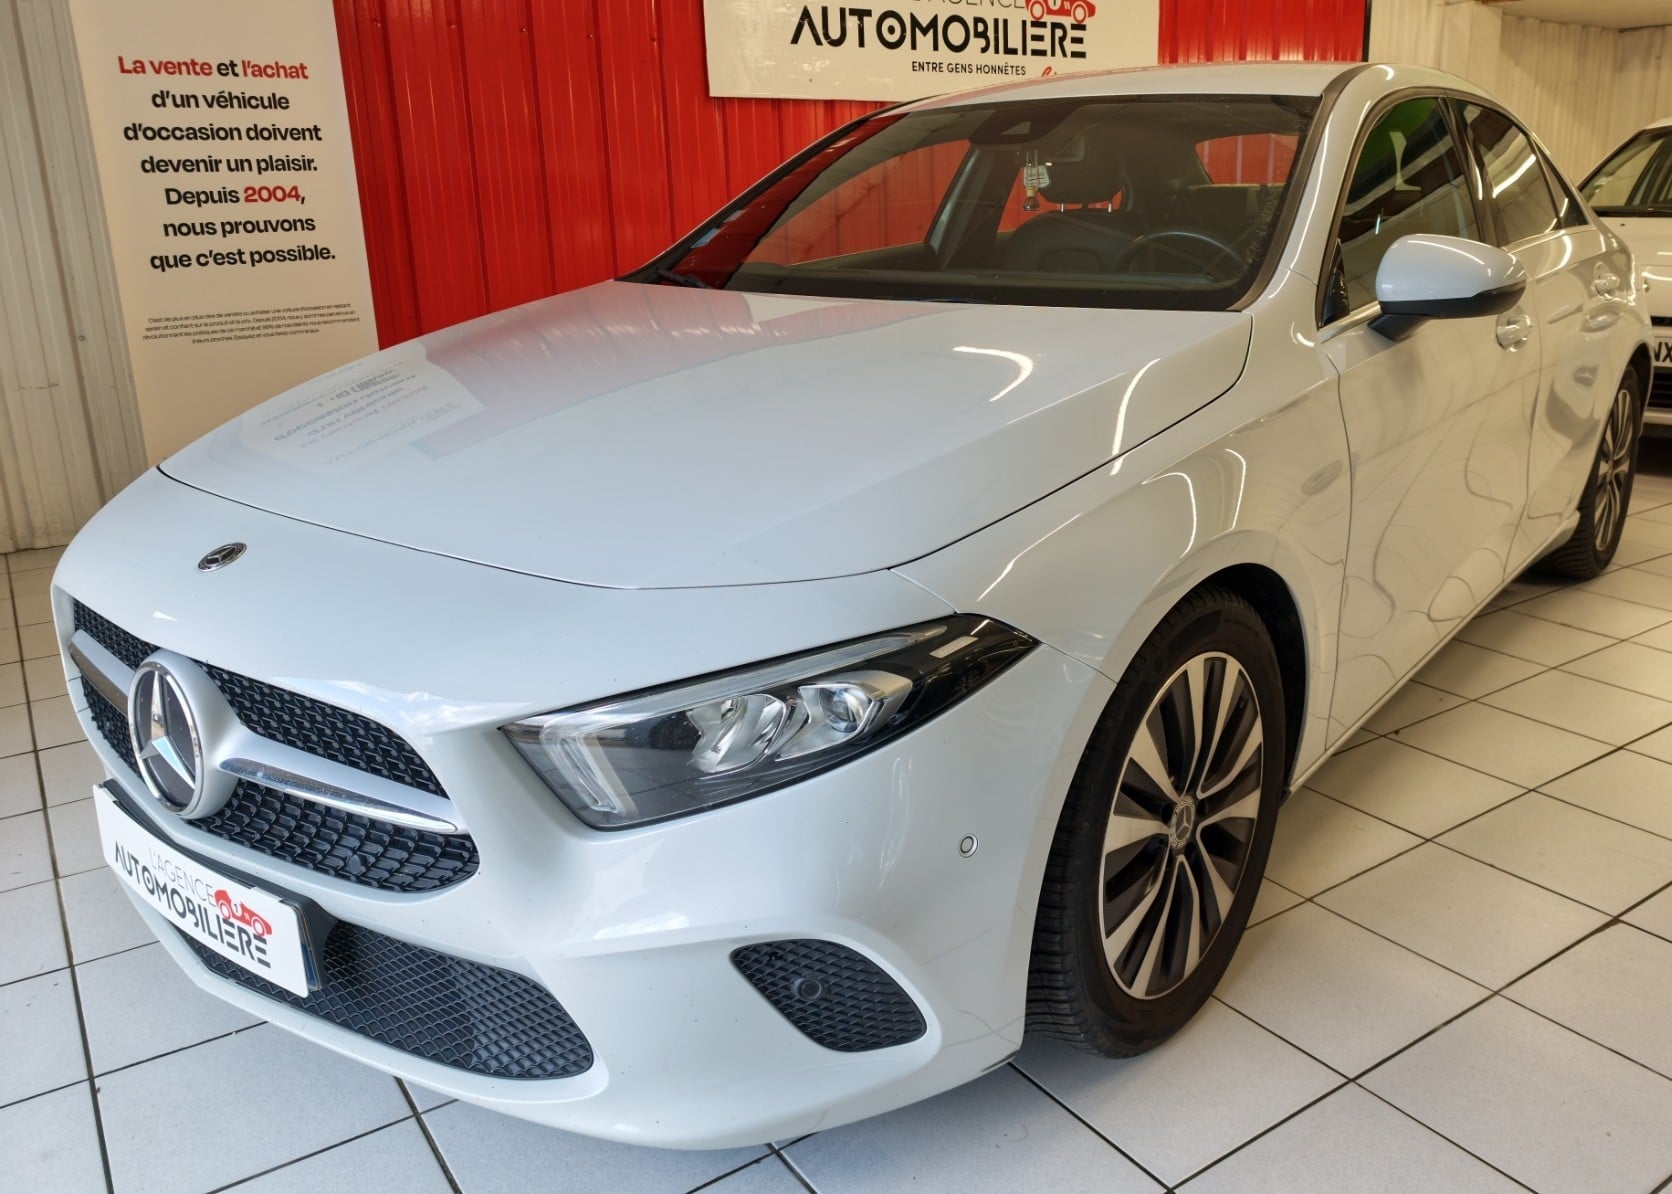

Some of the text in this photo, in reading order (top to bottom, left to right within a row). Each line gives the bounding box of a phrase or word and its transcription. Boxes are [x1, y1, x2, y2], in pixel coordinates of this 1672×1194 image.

[790, 5, 1087, 59] AUTOMOBILIERE
[118, 55, 309, 80] La vente et l'achat
[911, 61, 944, 75] ENTRE
[946, 62, 974, 76] GENS
[976, 62, 1027, 77] HONNÊTES
[151, 90, 290, 110] d'un véhicule
[123, 122, 322, 141] d'occasion doivent
[140, 154, 318, 175] devenir un plaisir.
[165, 185, 305, 207] Depuis 2004,
[163, 217, 316, 238] nous prouvons
[150, 244, 336, 272] que c'est possible.
[150, 850, 216, 907] L'AGENCE
[115, 840, 271, 969] AUTOMOBILIERE
